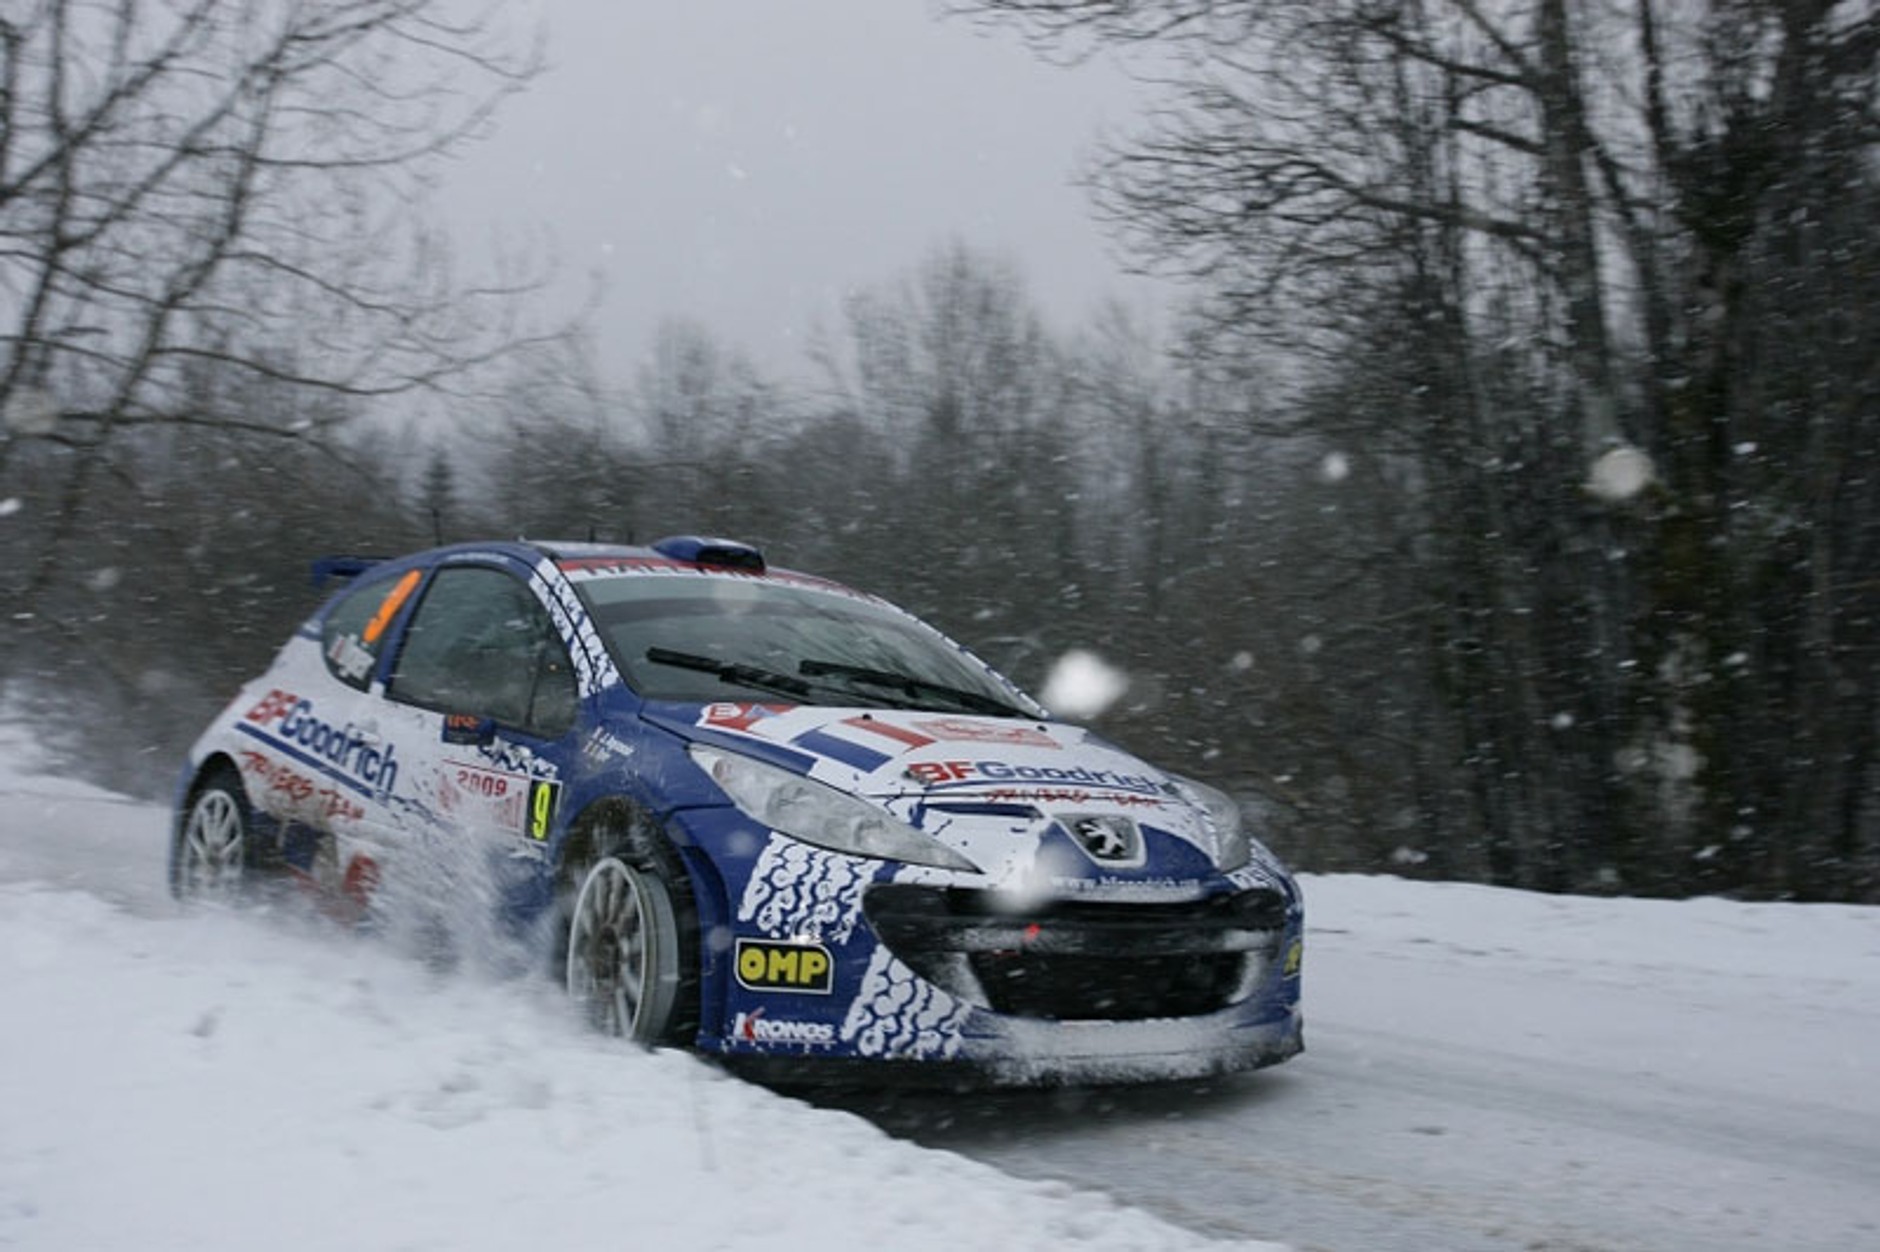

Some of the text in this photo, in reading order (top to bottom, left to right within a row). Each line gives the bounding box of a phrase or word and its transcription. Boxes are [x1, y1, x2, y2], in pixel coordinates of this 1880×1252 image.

[246, 689, 398, 793] BFGoodrich
[457, 770, 508, 797] 2009
[908, 761, 1159, 793] BFGoodrich
[533, 782, 551, 839] 9
[740, 947, 827, 984] OMP
[734, 1006, 834, 1041] KRONOS
